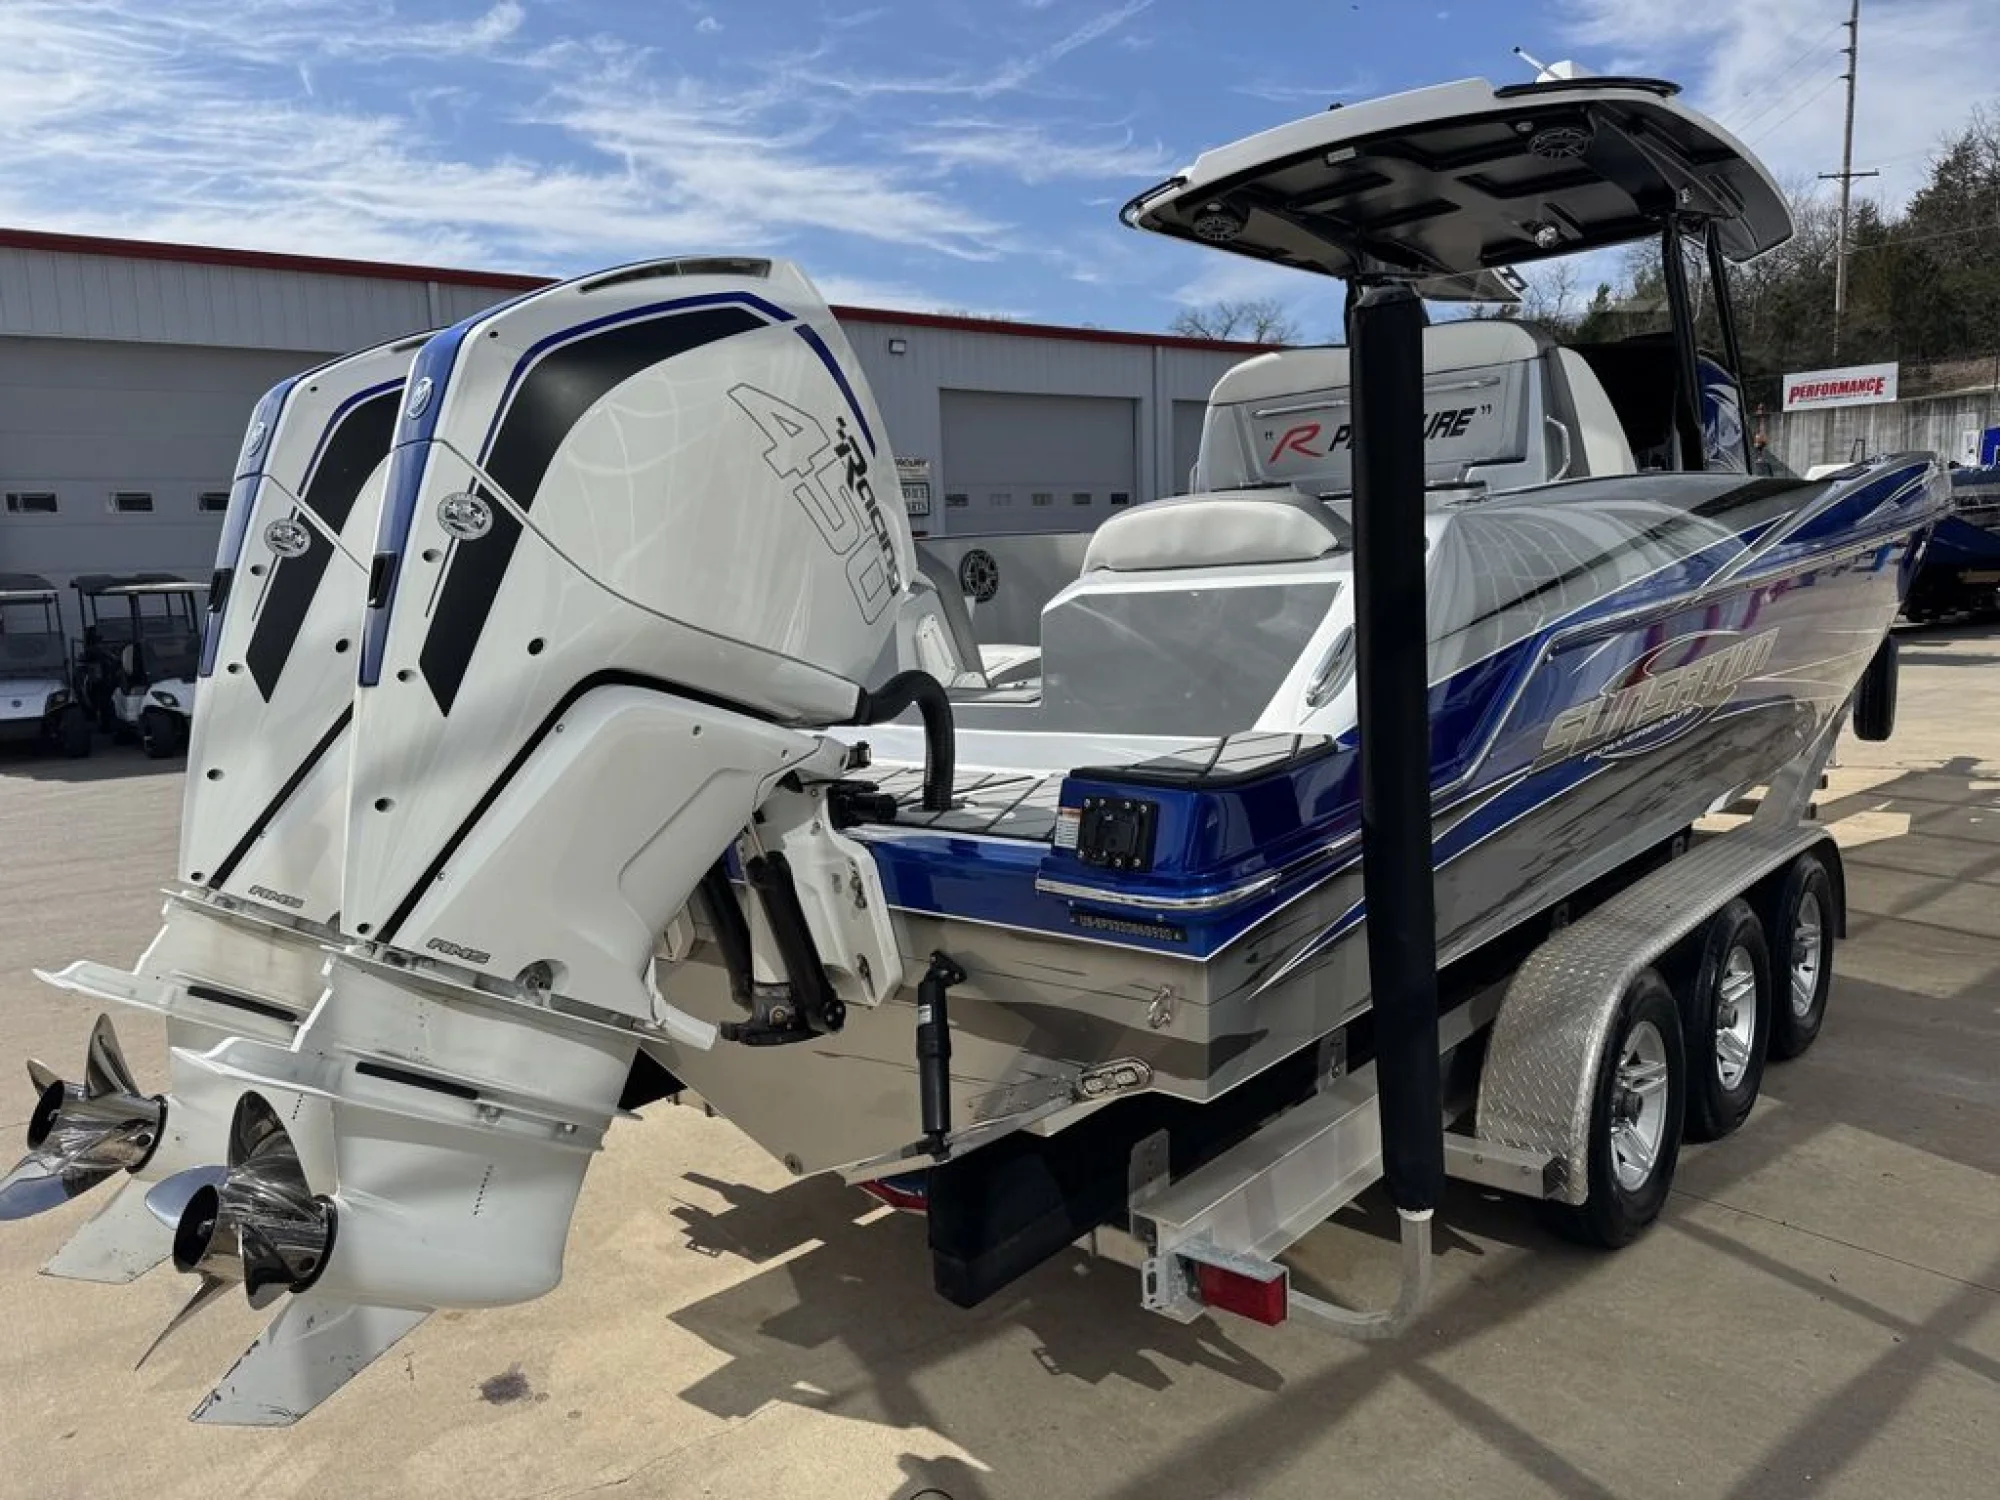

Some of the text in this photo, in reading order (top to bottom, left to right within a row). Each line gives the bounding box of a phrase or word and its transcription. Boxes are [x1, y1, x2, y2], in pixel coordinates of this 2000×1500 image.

[1788, 376, 1885, 404] PERFORMANCE
[726, 382, 896, 625] 450
[834, 416, 900, 597] Racing
